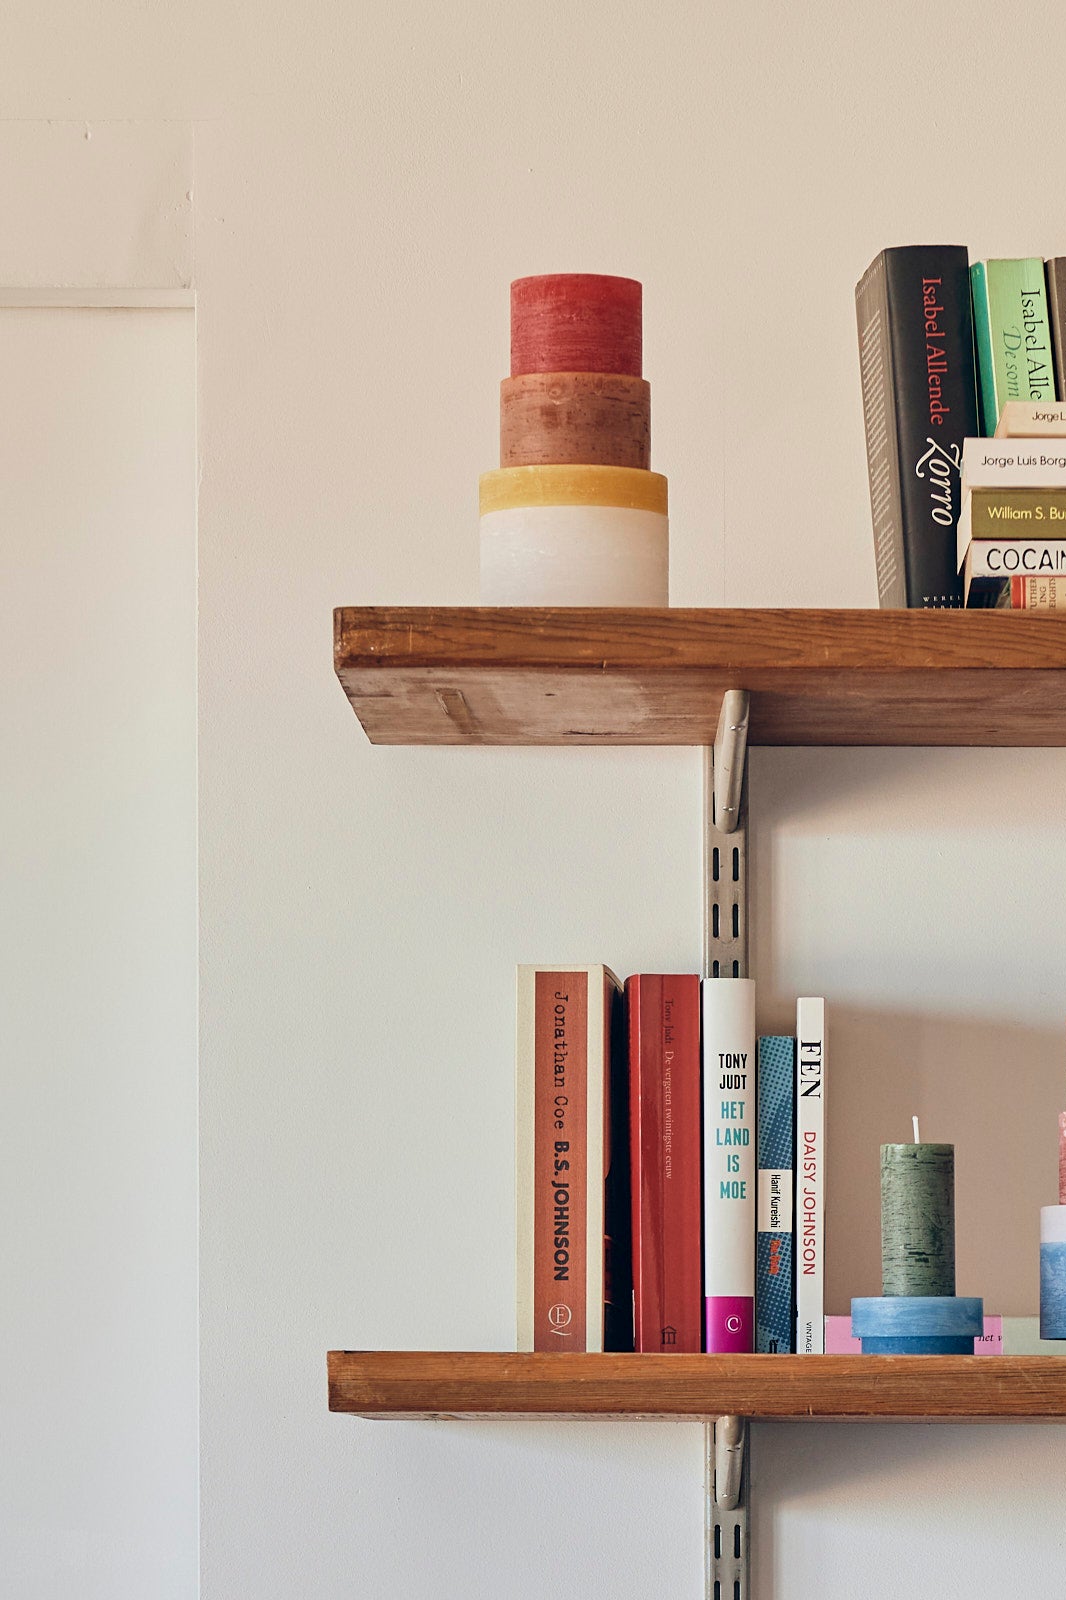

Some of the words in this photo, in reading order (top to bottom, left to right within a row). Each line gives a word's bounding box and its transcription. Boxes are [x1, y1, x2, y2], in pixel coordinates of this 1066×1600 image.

[922, 277, 946, 338] Isabel
[925, 345, 950, 426] Allende
[915, 437, 963, 526] Zorro
[988, 506, 1032, 520] William
[1035, 507, 1046, 520] S.
[554, 991, 568, 1088] Jonathan
[718, 1053, 748, 1069] TONY
[800, 1040, 821, 1099] FEN
[719, 1074, 747, 1090] JUDT
[554, 1095, 569, 1129] Coe
[721, 1101, 745, 1119] HET
[716, 1128, 750, 1146] LAND
[554, 1141, 570, 1176] B.S.
[727, 1154, 740, 1172] IS
[803, 1132, 816, 1182] DAISY
[720, 1181, 746, 1199] MOE
[771, 1174, 781, 1194] Hanif
[770, 1196, 781, 1228] Kureishi
[551, 1181, 570, 1281] JOHNSON
[803, 1187, 816, 1275] JOHNSON
